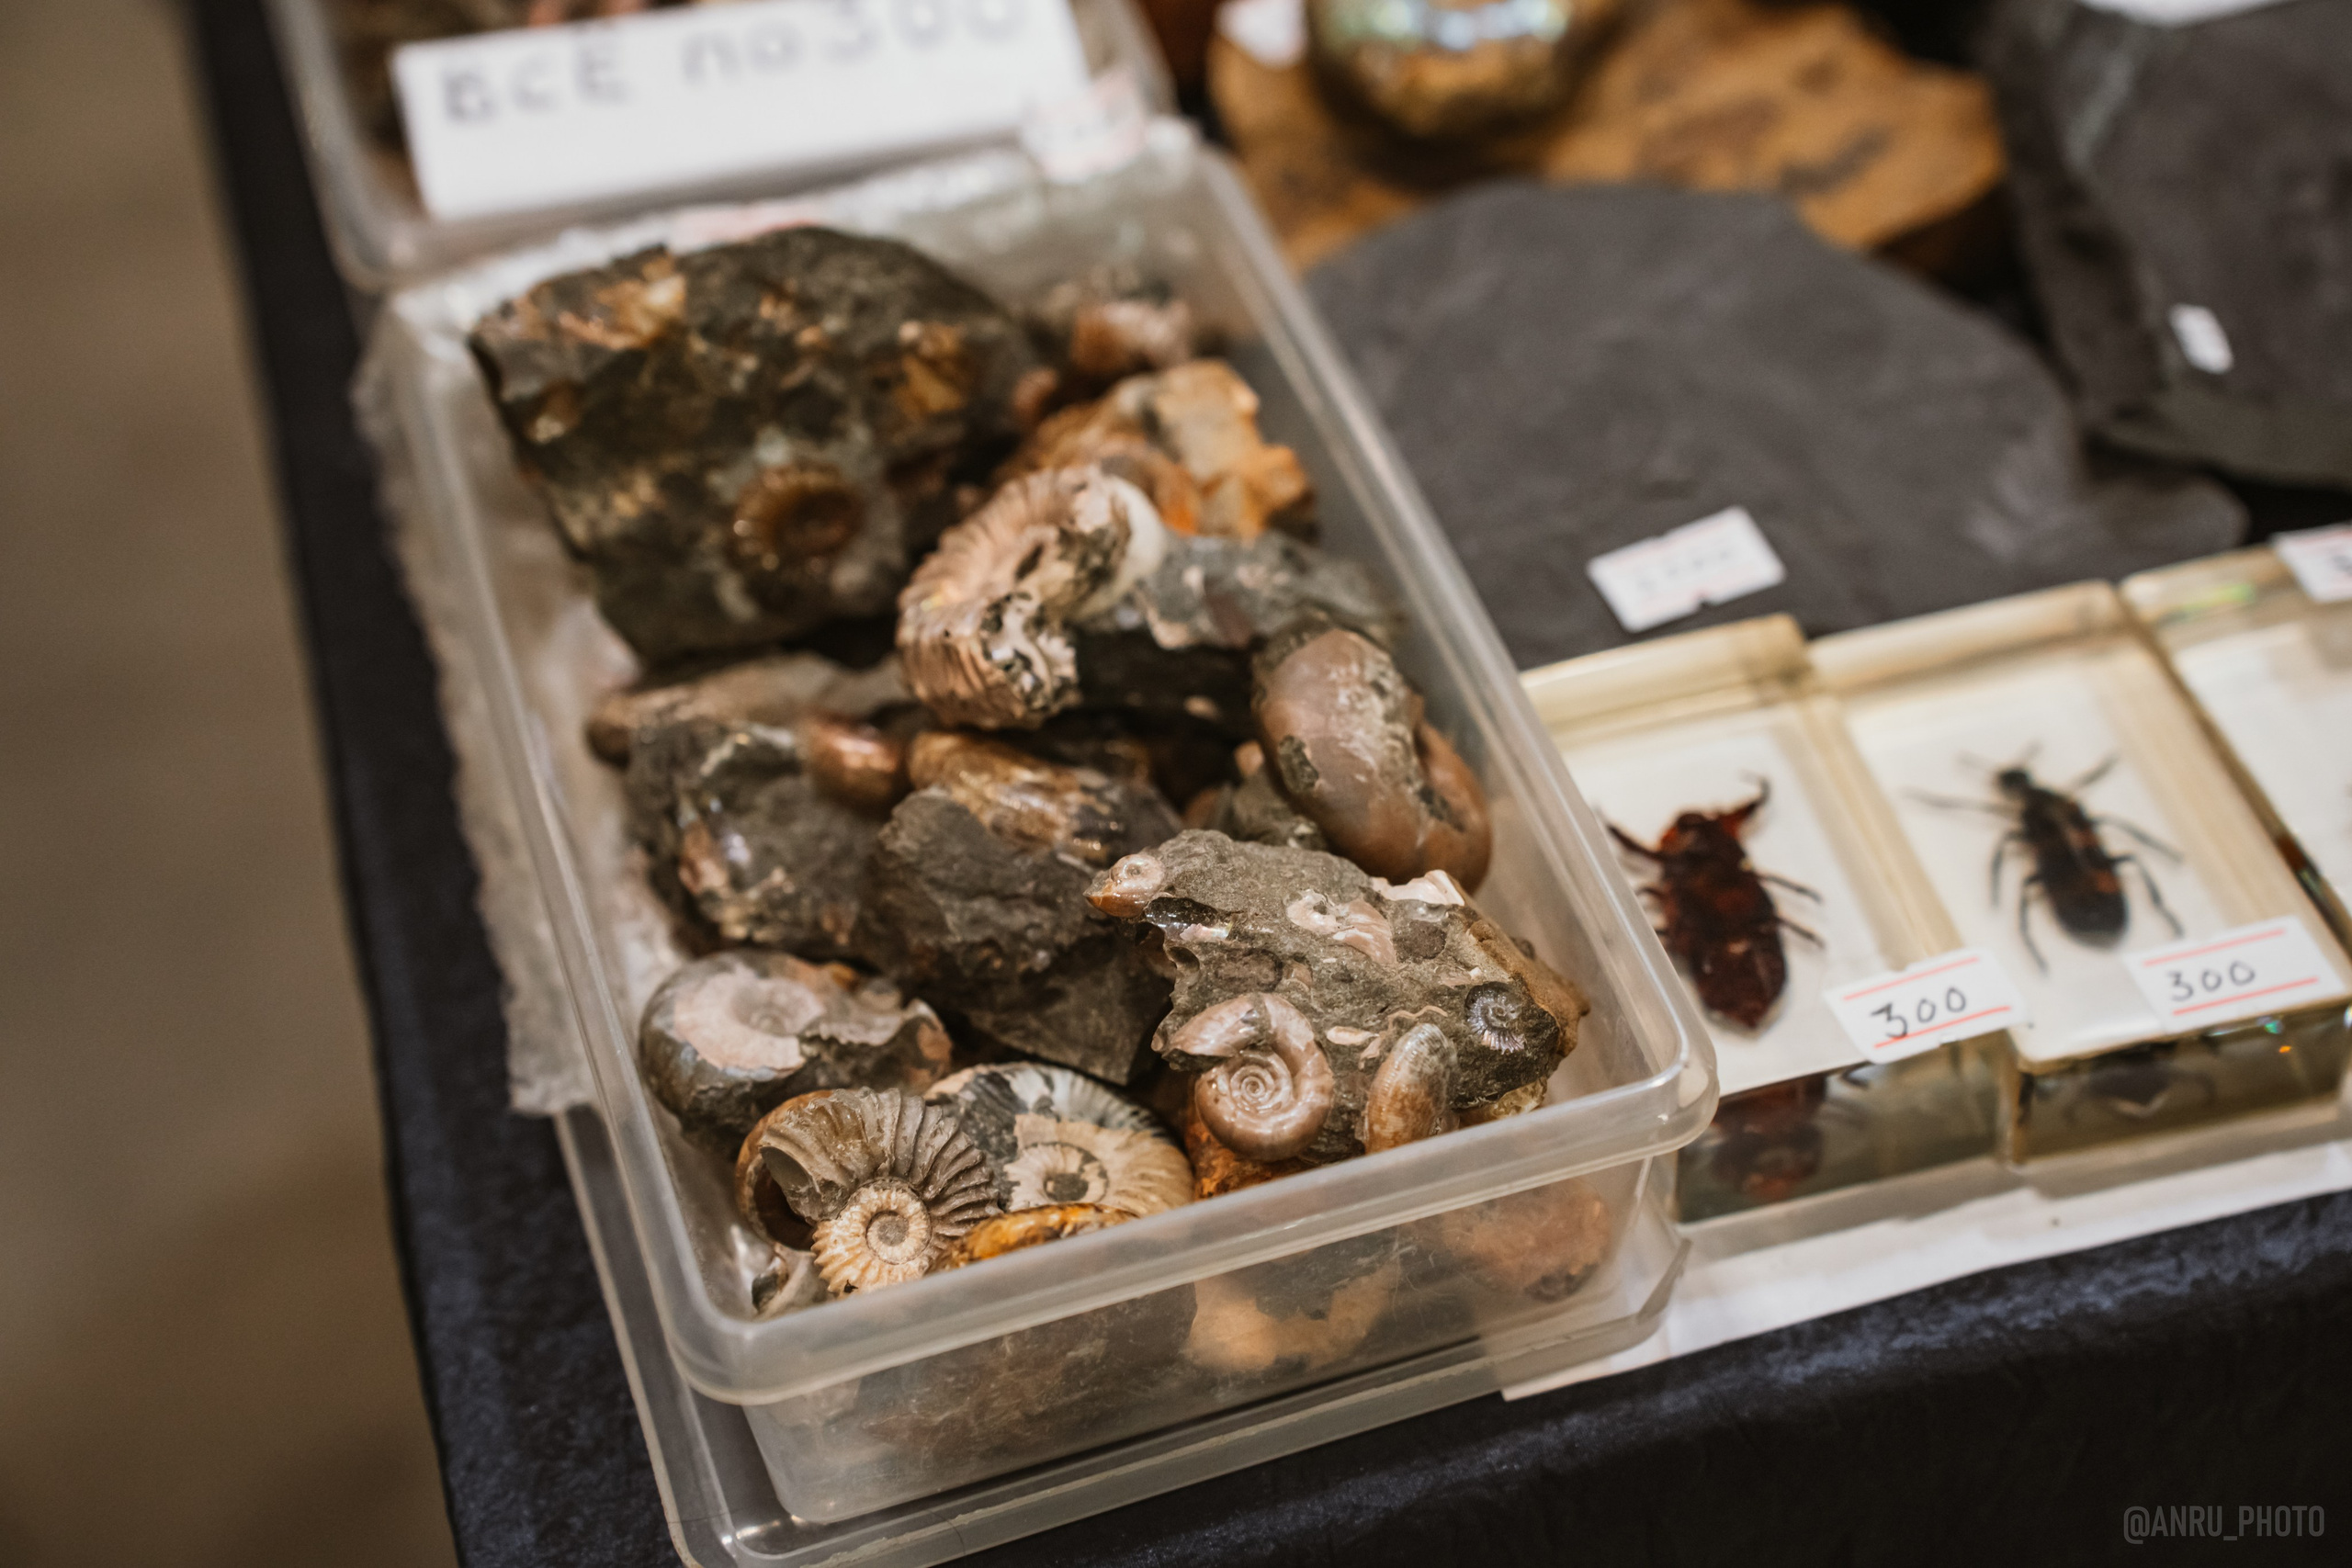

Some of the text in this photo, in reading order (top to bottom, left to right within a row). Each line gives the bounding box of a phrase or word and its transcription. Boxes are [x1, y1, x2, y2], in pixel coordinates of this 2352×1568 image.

[820, 0, 1029, 66] 300
[2167, 960, 2256, 1002] 300
[1871, 987, 1966, 1039] 300
